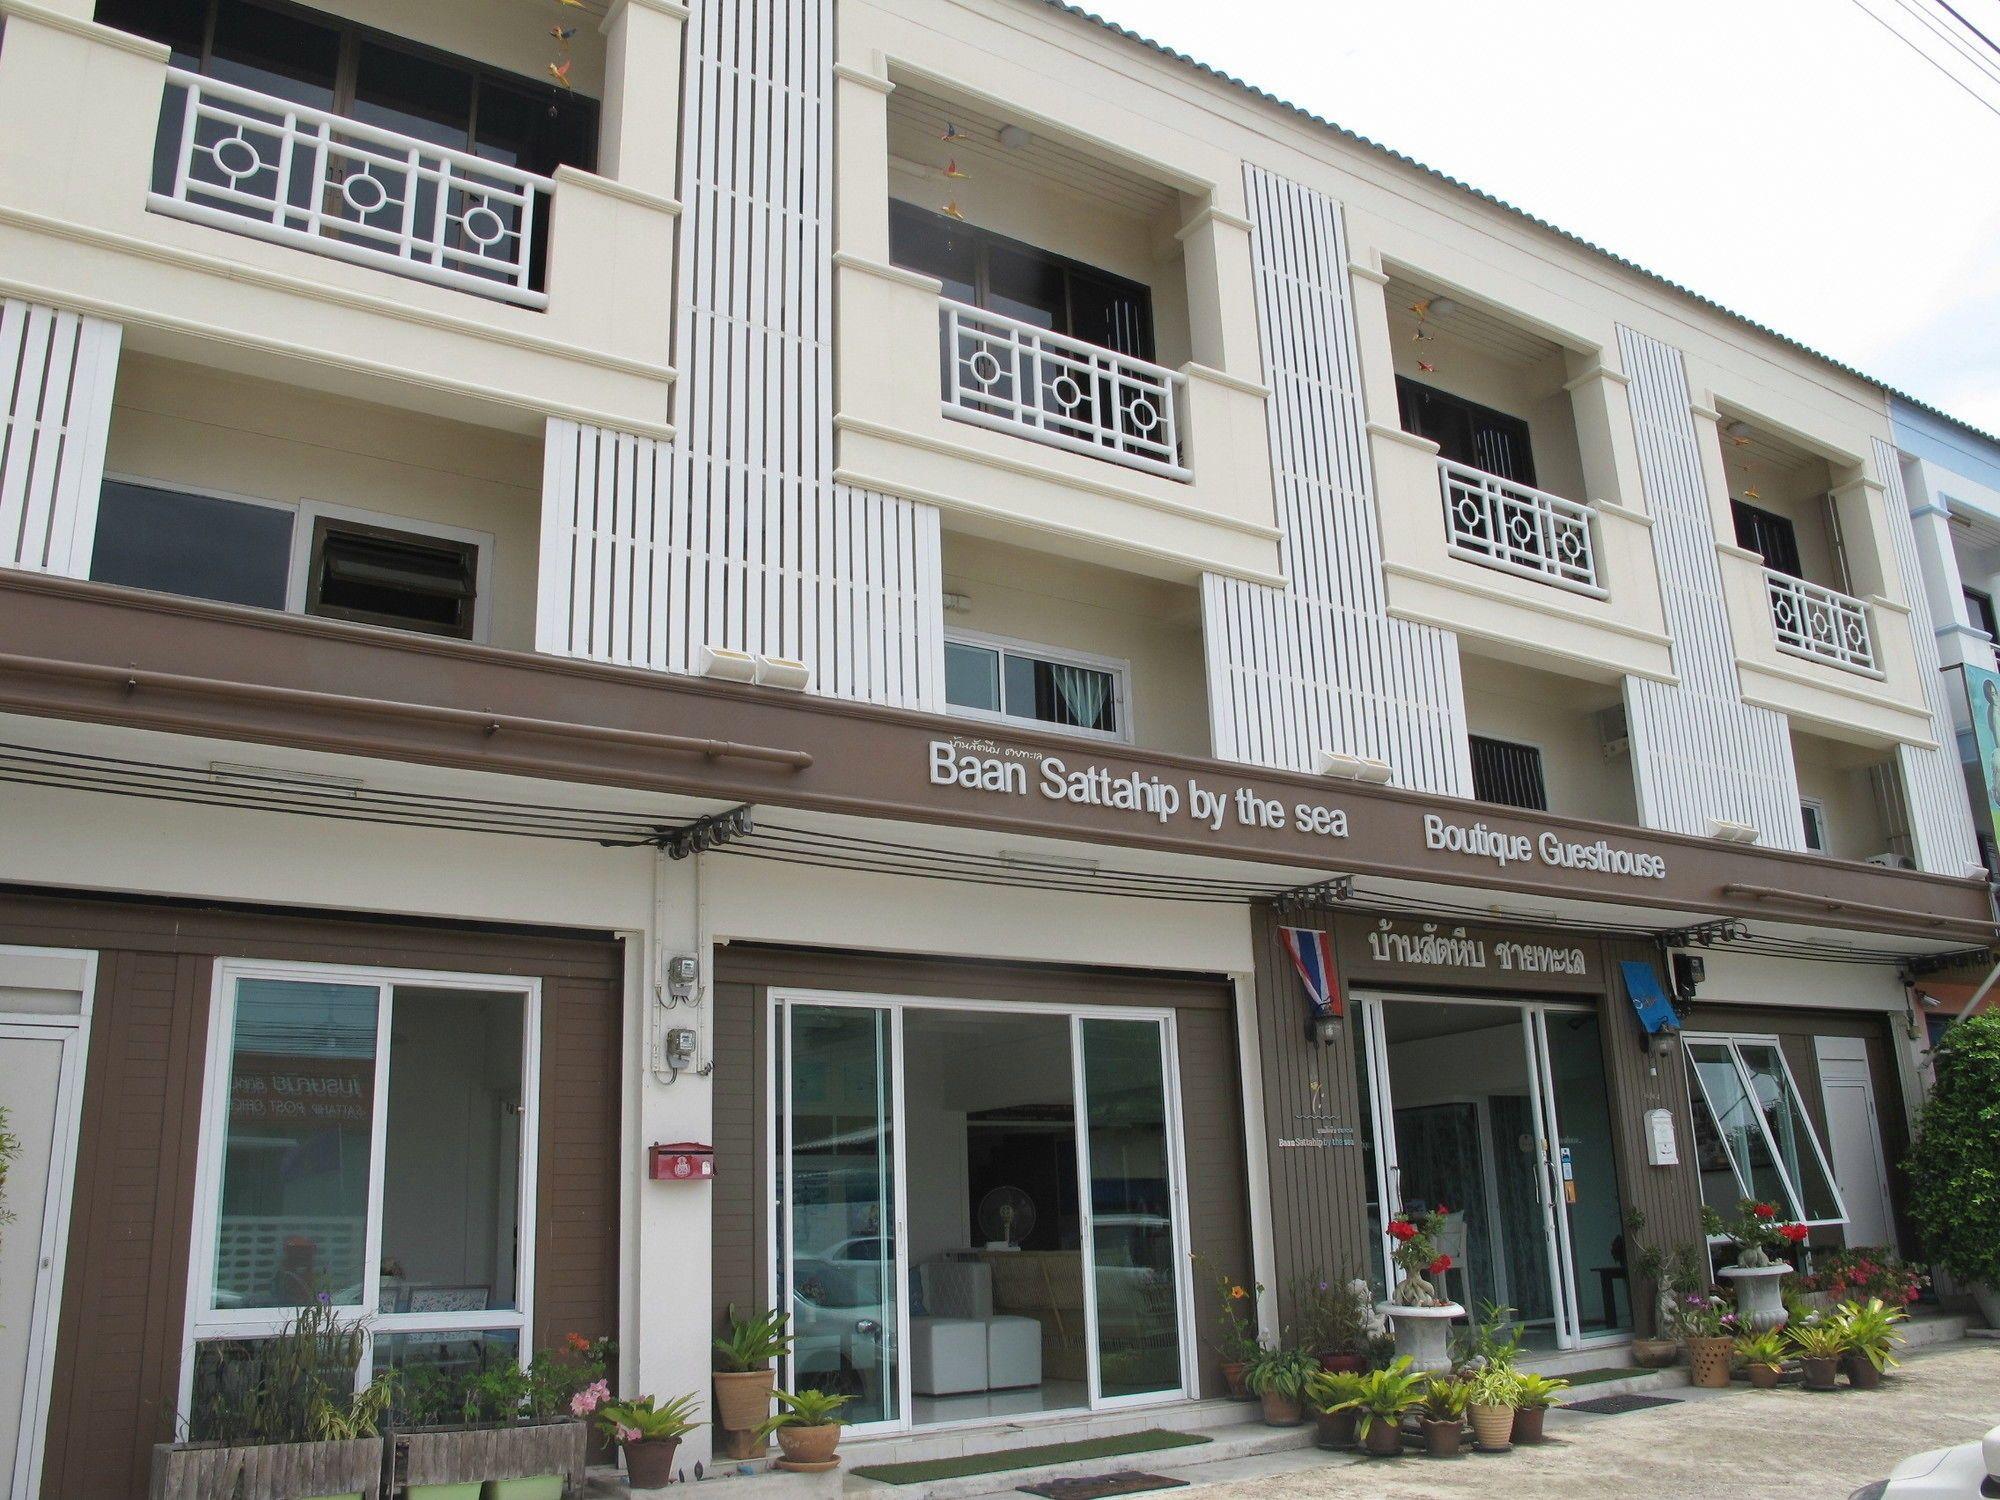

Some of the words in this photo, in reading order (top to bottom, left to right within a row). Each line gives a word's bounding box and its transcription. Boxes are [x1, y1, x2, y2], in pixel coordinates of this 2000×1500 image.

[929, 740, 1027, 795] Baan
[1040, 757, 1180, 823] Sattahip
[1188, 779, 1226, 831] by
[1234, 787, 1286, 829] the
[1295, 804, 1349, 838] sea
[1423, 814, 1532, 866] Boutique
[1538, 831, 1666, 879] Guesthouse
[1367, 918, 1486, 968] บ้านสัตหีบ
[1494, 940, 1586, 975] ชายทะเล
[1278, 1138, 1295, 1147] Baan
[1295, 1137, 1323, 1148] Sattahip
